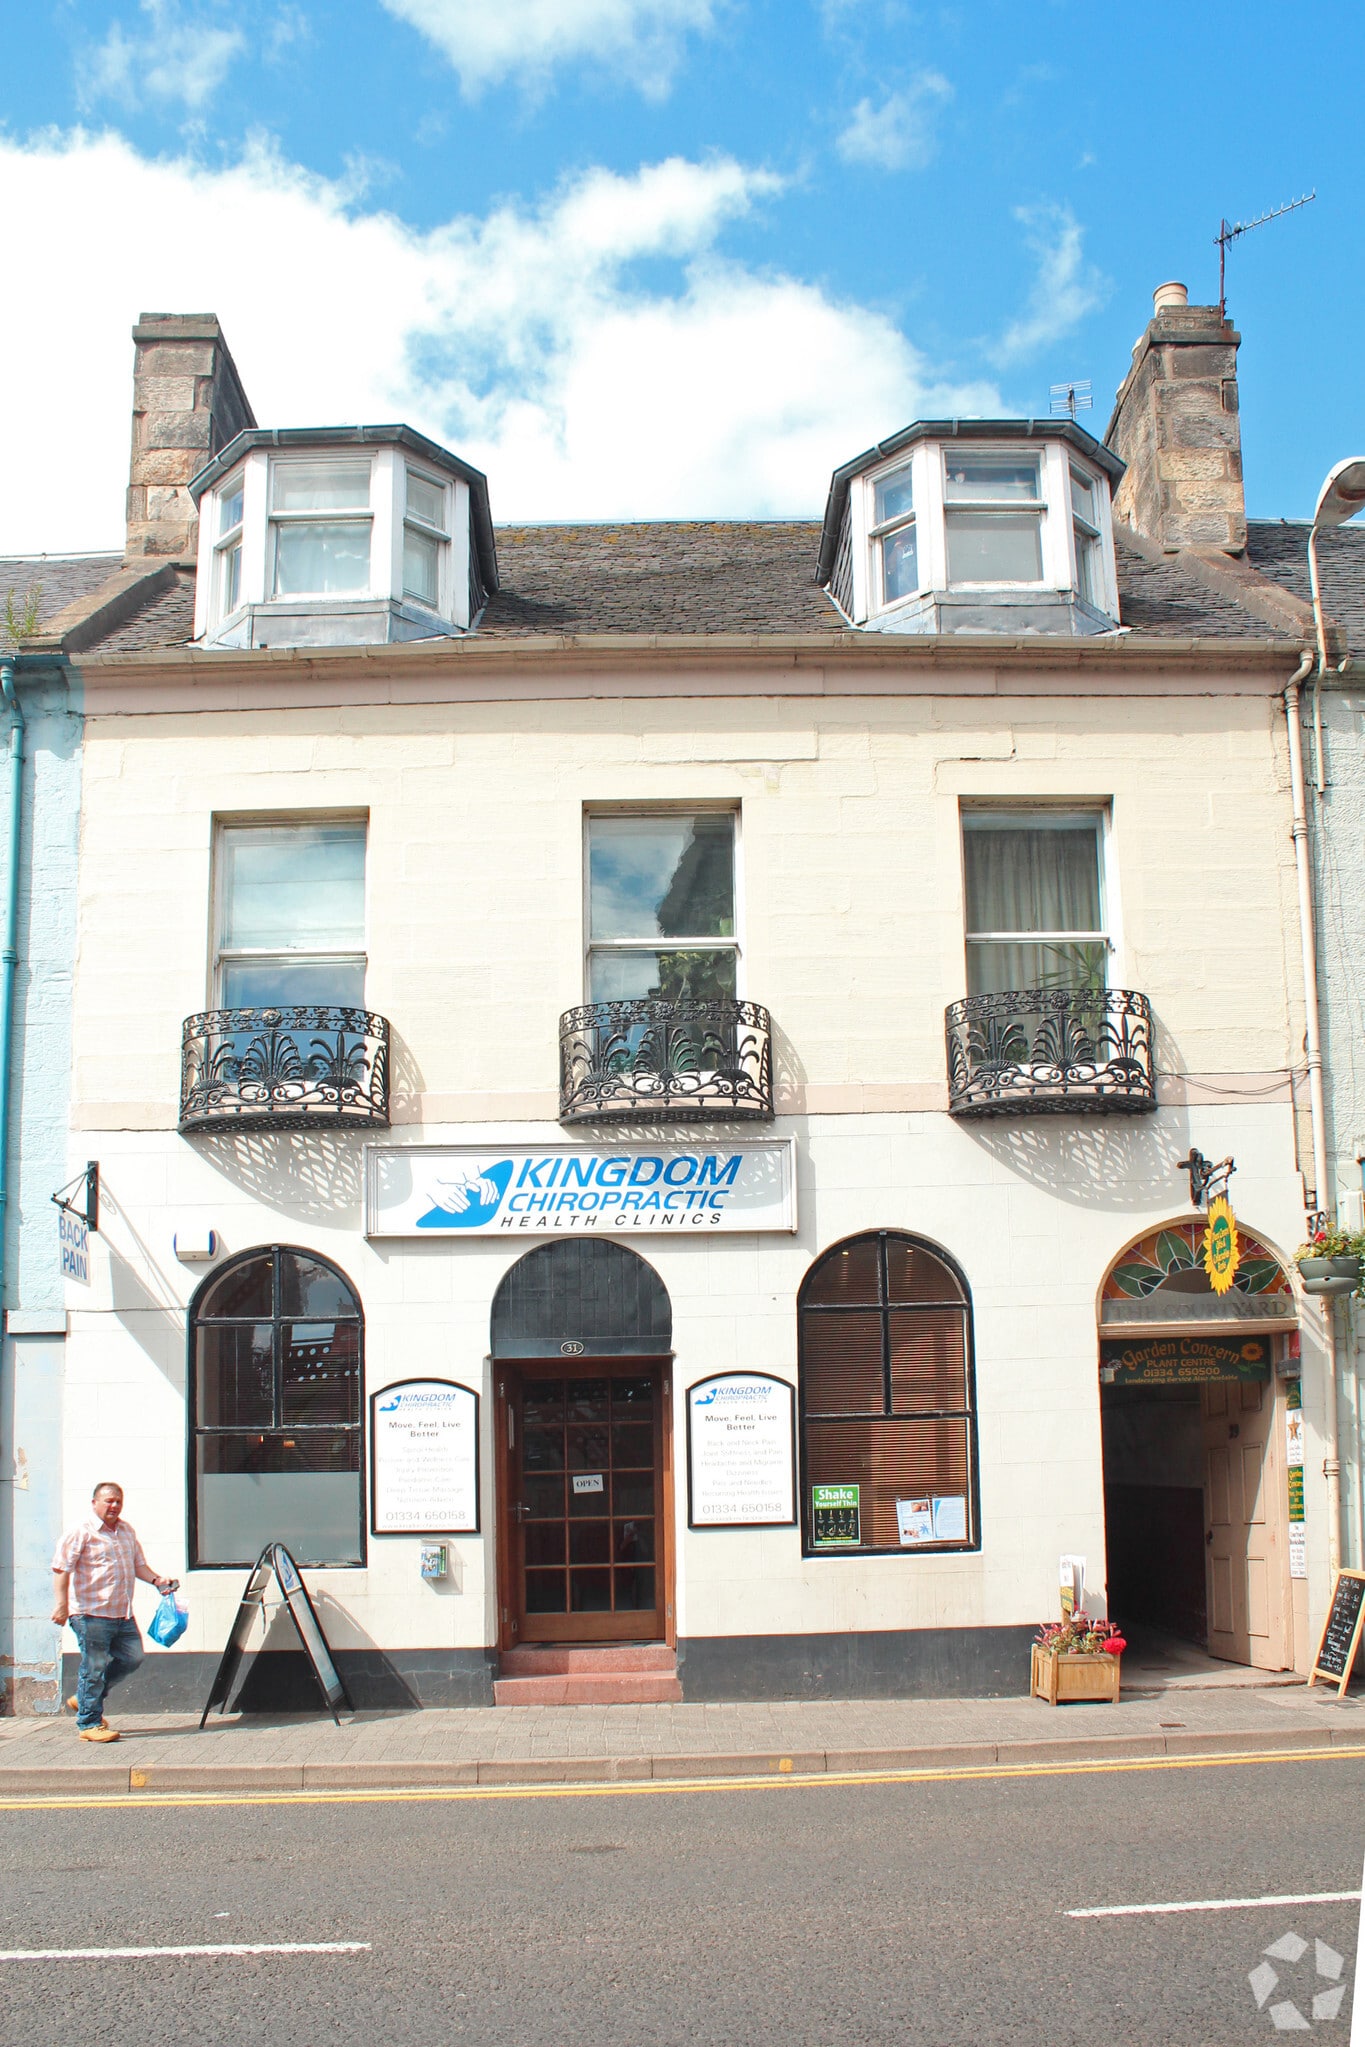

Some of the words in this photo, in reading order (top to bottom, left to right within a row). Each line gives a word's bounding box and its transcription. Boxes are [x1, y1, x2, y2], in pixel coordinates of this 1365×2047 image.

[516, 1155, 743, 1188] KINGDOM
[508, 1189, 729, 1212] CHIROPRACTIC
[500, 1215, 598, 1228] HEALTH
[614, 1213, 722, 1226] CLINICS
[59, 1215, 89, 1252] BACK
[63, 1246, 88, 1280] PAIN
[1162, 1301, 1288, 1320] COURTYARD
[566, 1343, 578, 1353] 31
[1122, 1341, 1177, 1371] Garden
[1180, 1338, 1240, 1364] Concern
[1146, 1359, 1179, 1368] PLANT
[1181, 1358, 1217, 1367] CENTRE
[1143, 1369, 1174, 1378] 01334
[1178, 1367, 1221, 1376] 650500
[718, 1386, 772, 1395] KINGDOM
[402, 1393, 456, 1402] KINGDOM
[758, 1413, 777, 1421] Live
[442, 1420, 461, 1428] Live
[726, 1423, 755, 1431] Better
[410, 1430, 439, 1438] Better
[576, 1479, 600, 1488] OPEN
[818, 1488, 854, 1500] Shake
[702, 1503, 737, 1514] 01334
[741, 1502, 783, 1513] 650158
[815, 1500, 842, 1509] Yourself
[842, 1499, 858, 1508] Thin
[386, 1511, 421, 1521] 01334
[425, 1510, 466, 1520] 650158
